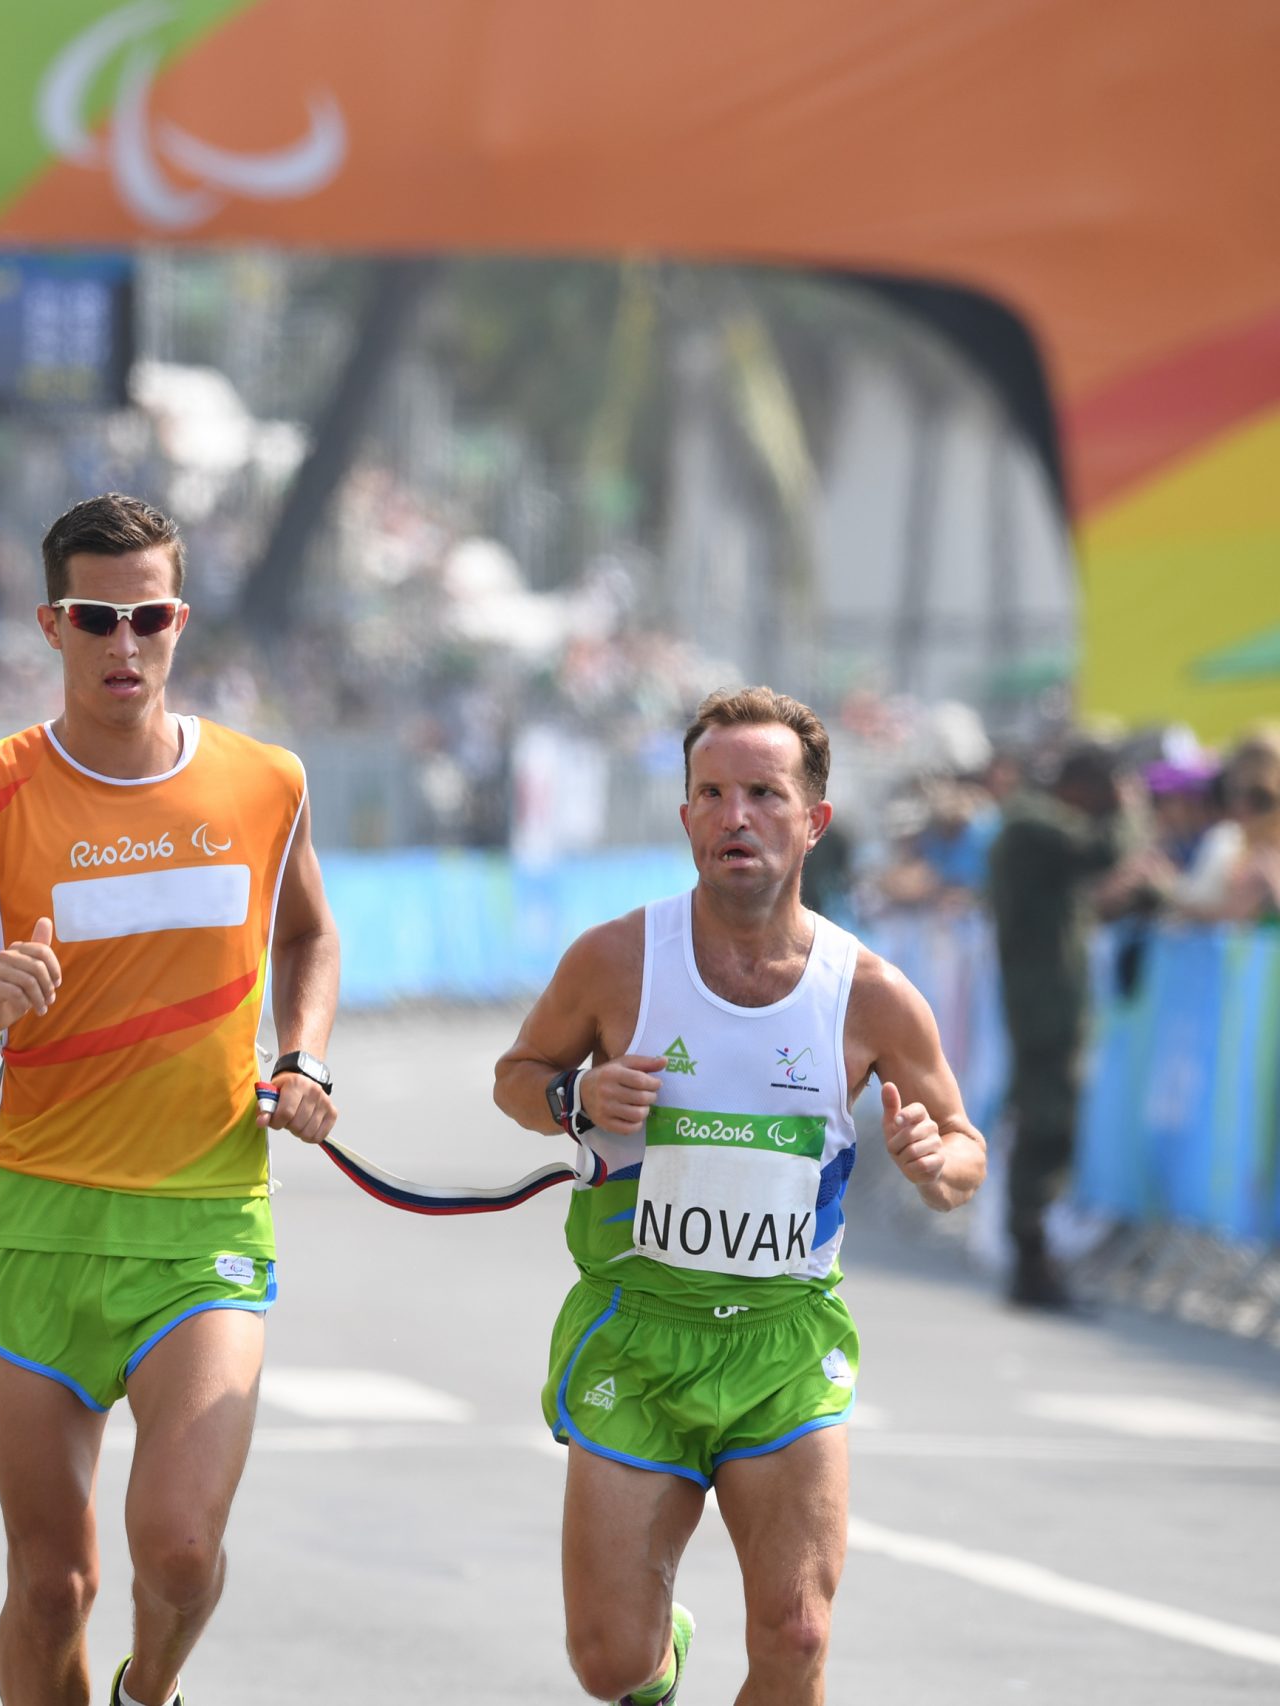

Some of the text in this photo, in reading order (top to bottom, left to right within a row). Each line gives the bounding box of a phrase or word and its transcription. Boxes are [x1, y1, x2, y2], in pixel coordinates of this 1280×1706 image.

[71, 832, 174, 868] Rio2016
[658, 1056, 699, 1076] EAK
[676, 1117, 755, 1142] Rio2016
[639, 1200, 811, 1262] NOVAK
